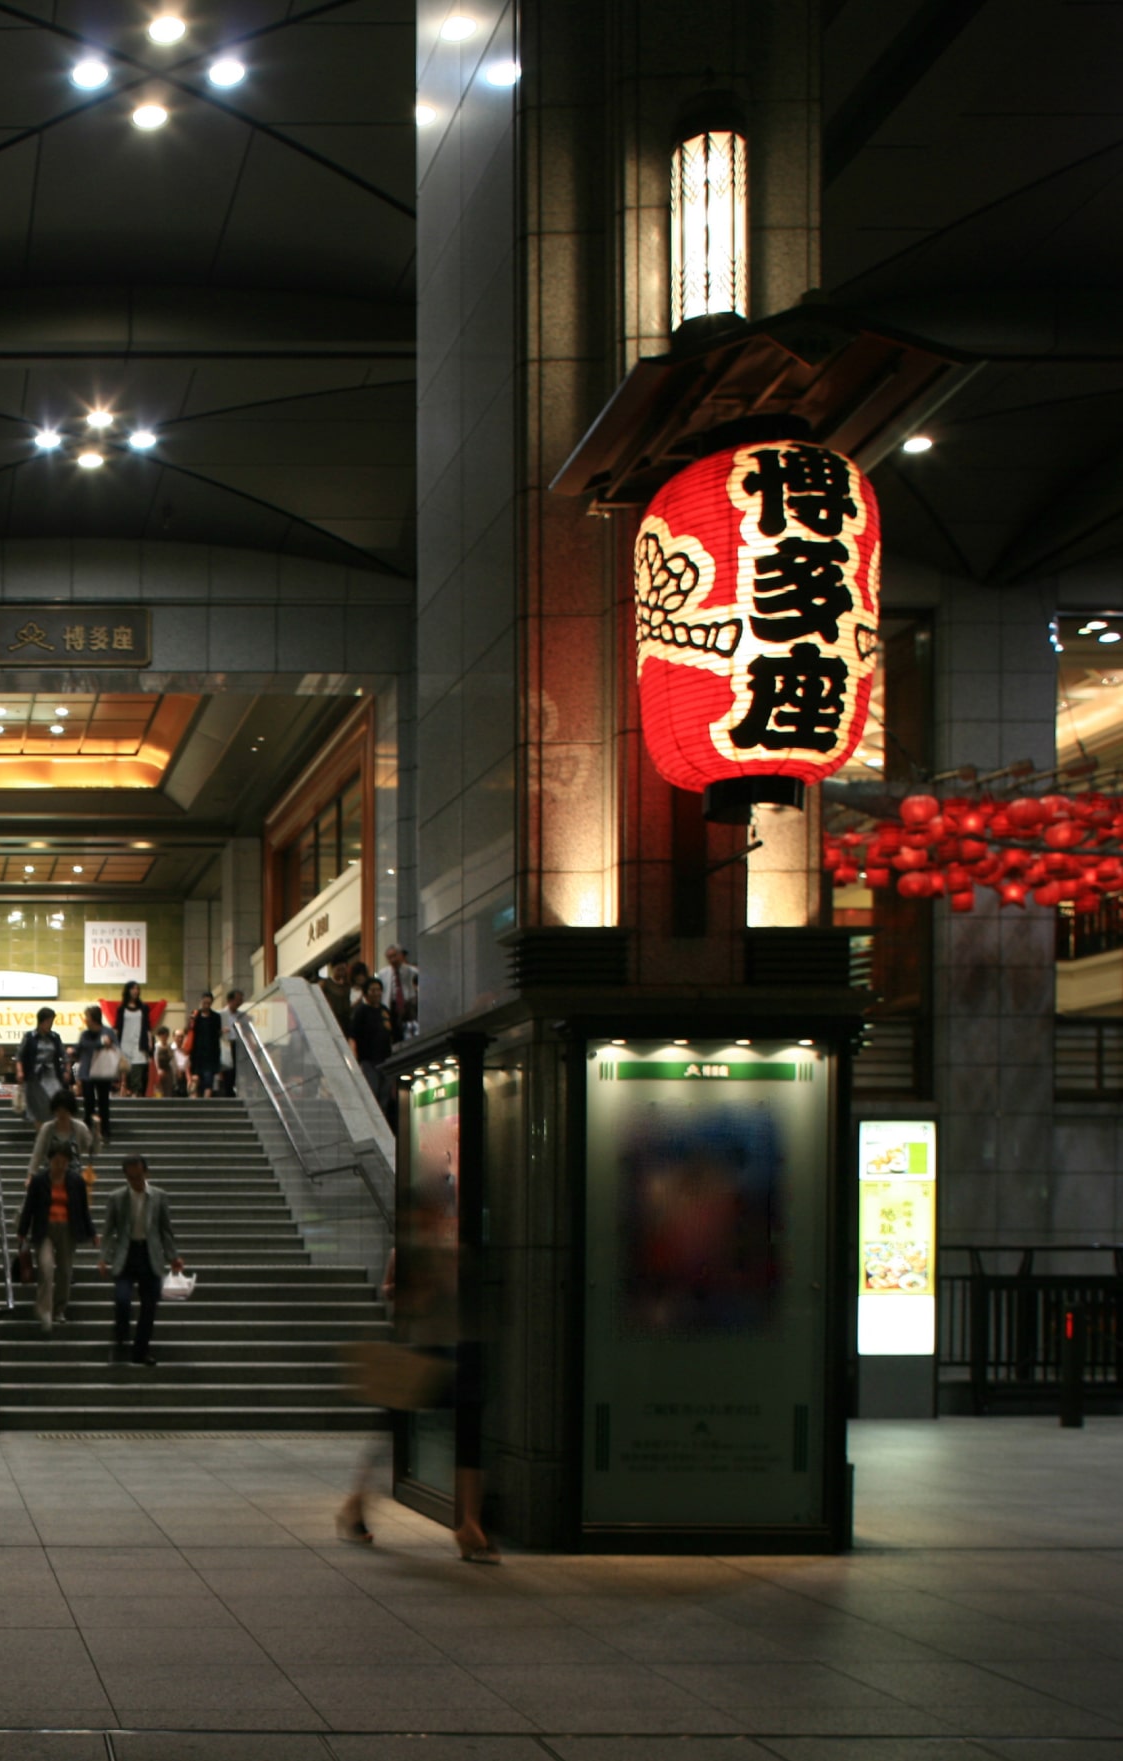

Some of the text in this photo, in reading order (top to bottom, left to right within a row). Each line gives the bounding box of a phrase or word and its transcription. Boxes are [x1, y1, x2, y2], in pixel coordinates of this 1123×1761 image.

[62, 625, 133, 651] 博多座
[729, 442, 857, 752] 博多座
